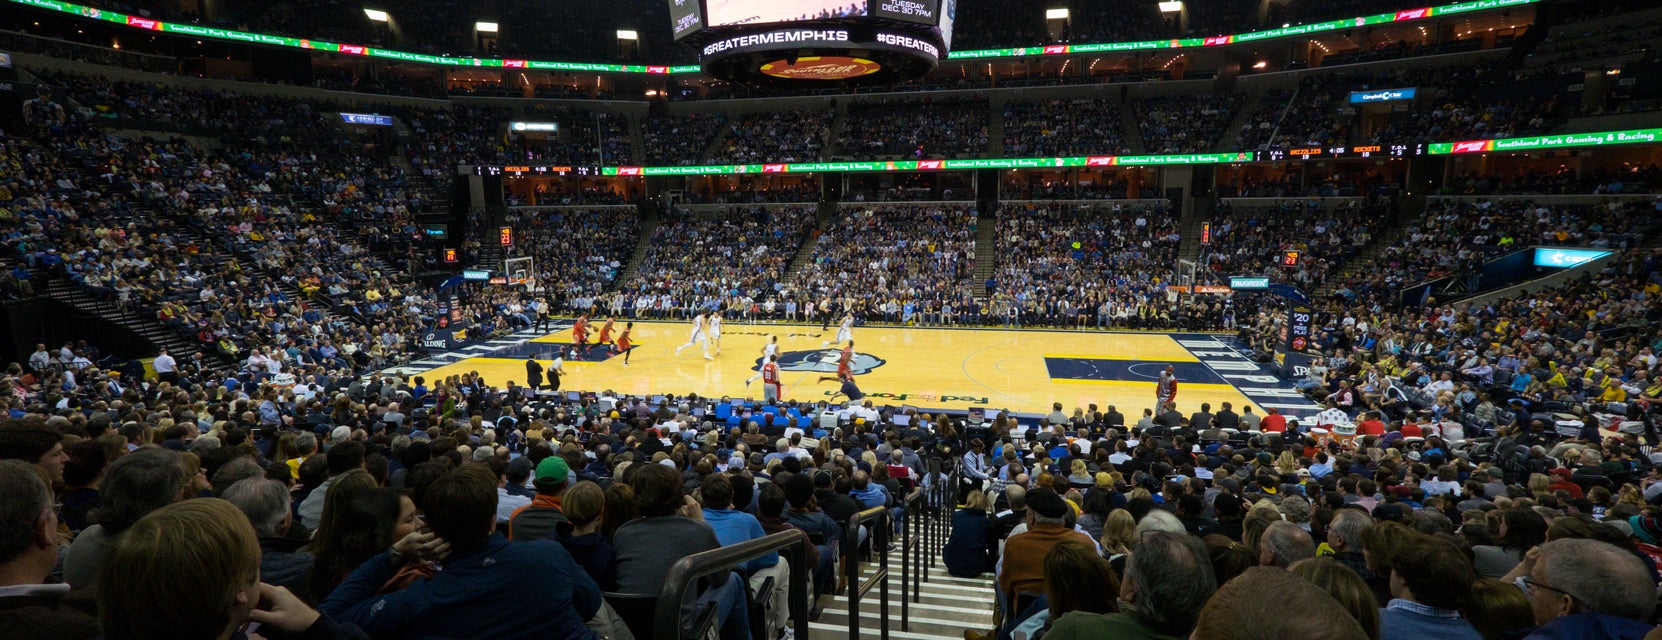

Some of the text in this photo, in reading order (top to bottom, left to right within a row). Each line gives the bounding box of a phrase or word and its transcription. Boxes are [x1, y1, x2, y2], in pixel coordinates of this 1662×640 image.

[882, 3, 900, 13] DEC.
[915, 8, 932, 18] 7PM
[1439, 1, 1477, 14] Southland
[703, 30, 849, 56] #GREATERMEMPHIS
[1496, 132, 1655, 149] Southland Park Gaming & Racing
[989, 160, 1011, 168] Gaming
[1166, 156, 1190, 164] Gaming
[1197, 155, 1219, 163] Racing
[1293, 312, 1310, 323] $20
